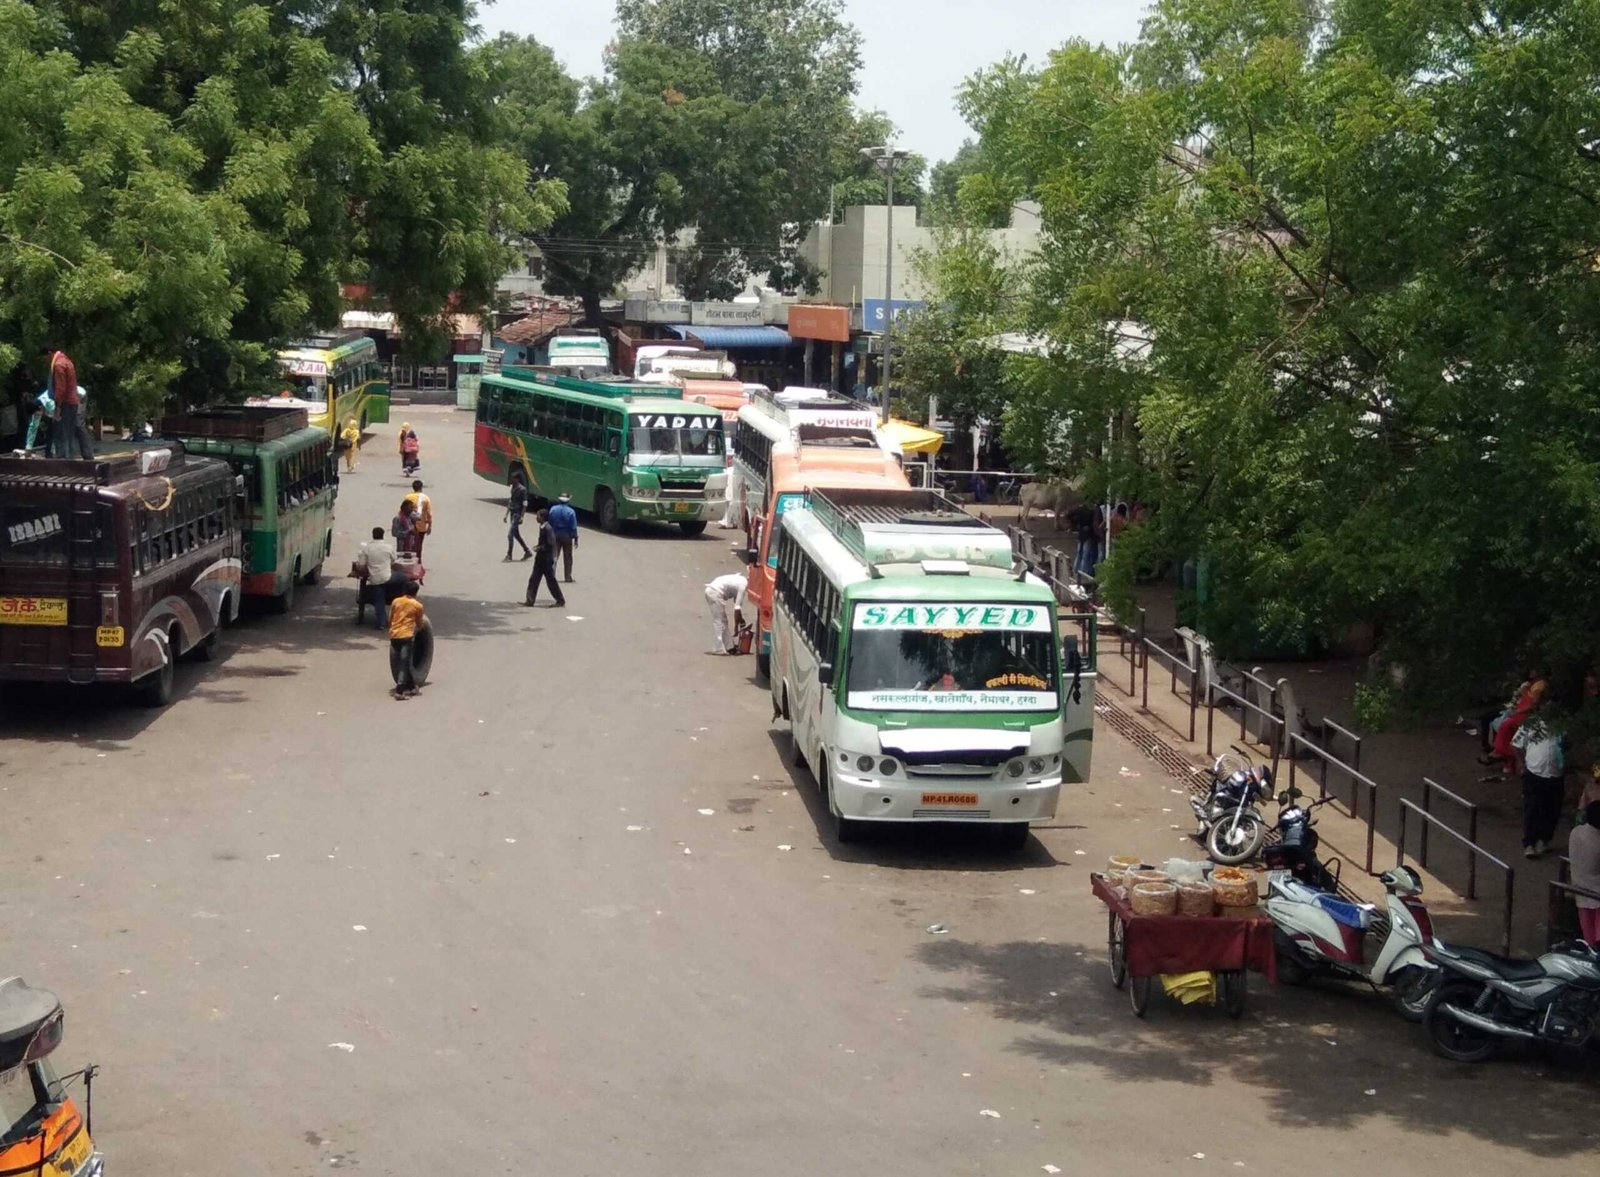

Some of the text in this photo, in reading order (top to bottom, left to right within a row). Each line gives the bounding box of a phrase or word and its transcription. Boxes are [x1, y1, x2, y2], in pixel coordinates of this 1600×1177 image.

[722, 310, 735, 319] बाबा
[637, 414, 718, 429] YADAV
[862, 605, 1038, 628] SAYYED
